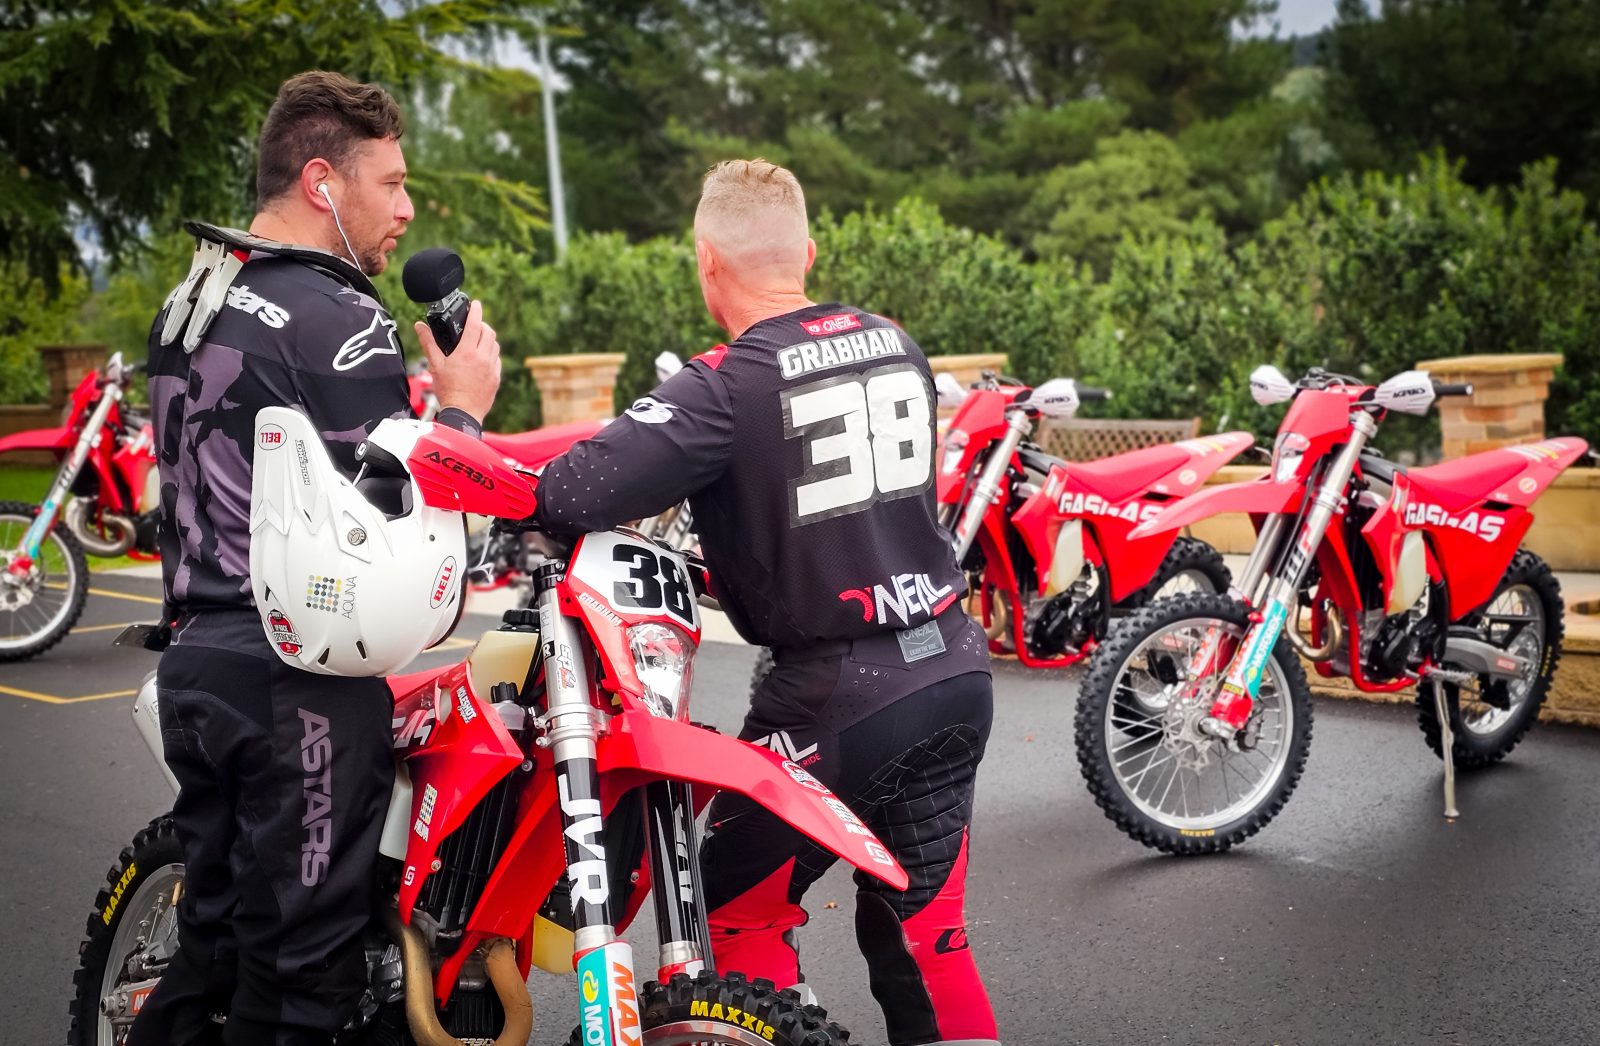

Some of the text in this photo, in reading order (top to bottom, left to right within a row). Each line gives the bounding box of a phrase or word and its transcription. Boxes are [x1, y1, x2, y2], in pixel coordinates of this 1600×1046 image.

[780, 328, 904, 378] GRABHAM
[260, 432, 281, 443] BELL
[789, 370, 932, 517] 38
[433, 564, 454, 602] BELL
[612, 543, 696, 626] 38
[297, 707, 333, 887] ASTARS
[557, 773, 609, 916] JVR
[102, 862, 137, 926] MAXXIS
[690, 1000, 775, 1041] MAXXIS
